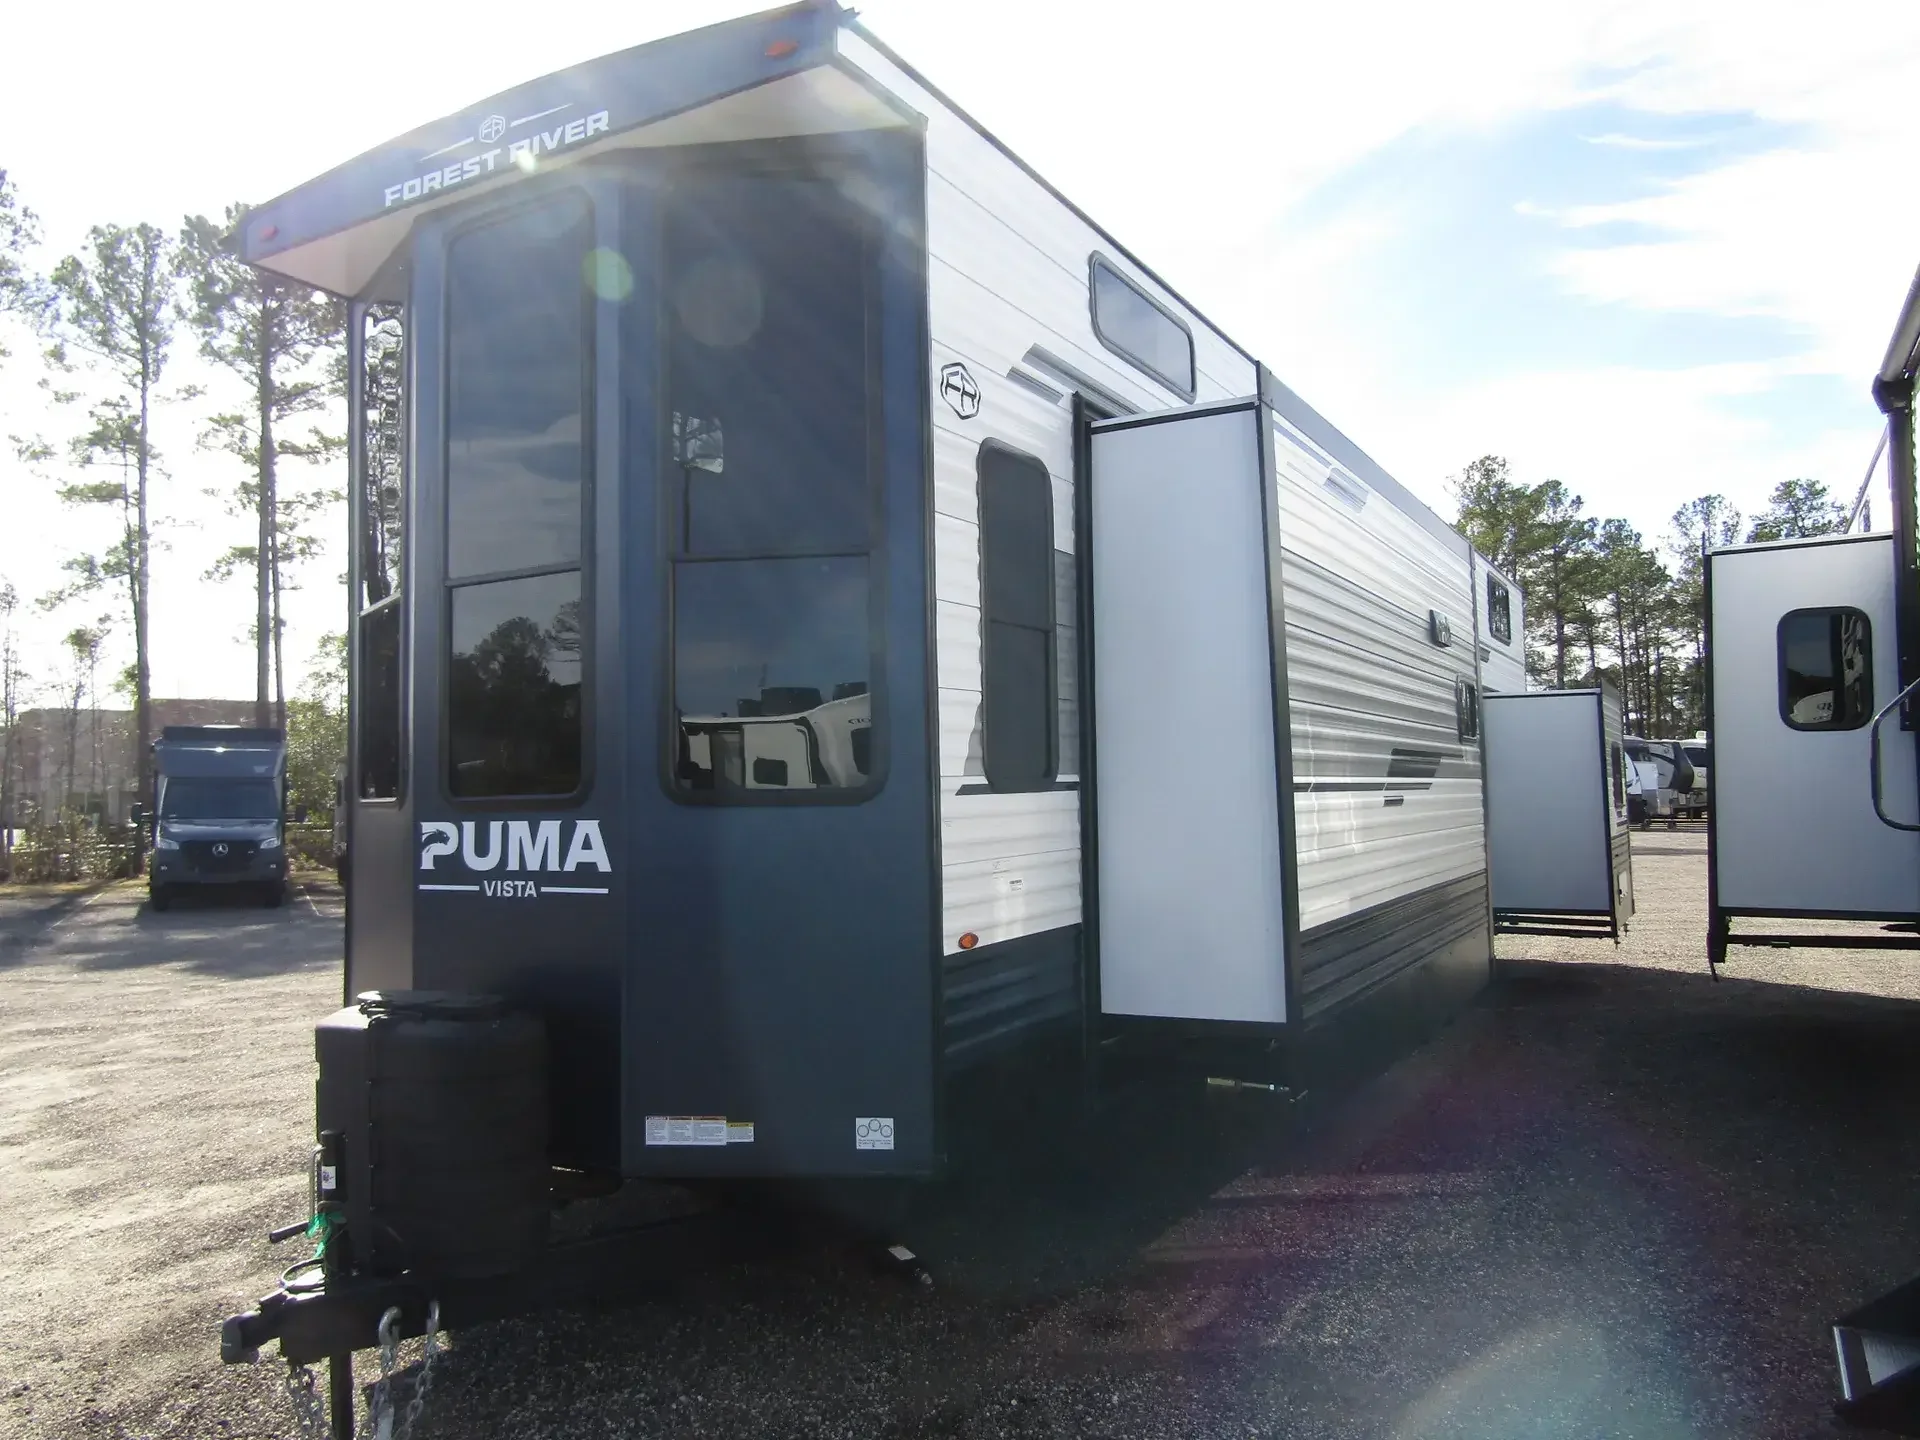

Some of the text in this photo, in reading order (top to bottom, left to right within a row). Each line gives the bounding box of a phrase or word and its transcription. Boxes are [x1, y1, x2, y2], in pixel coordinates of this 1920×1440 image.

[384, 110, 609, 207] FOREST RIVER
[420, 819, 612, 872] PUMA
[483, 880, 537, 897] VISTA
